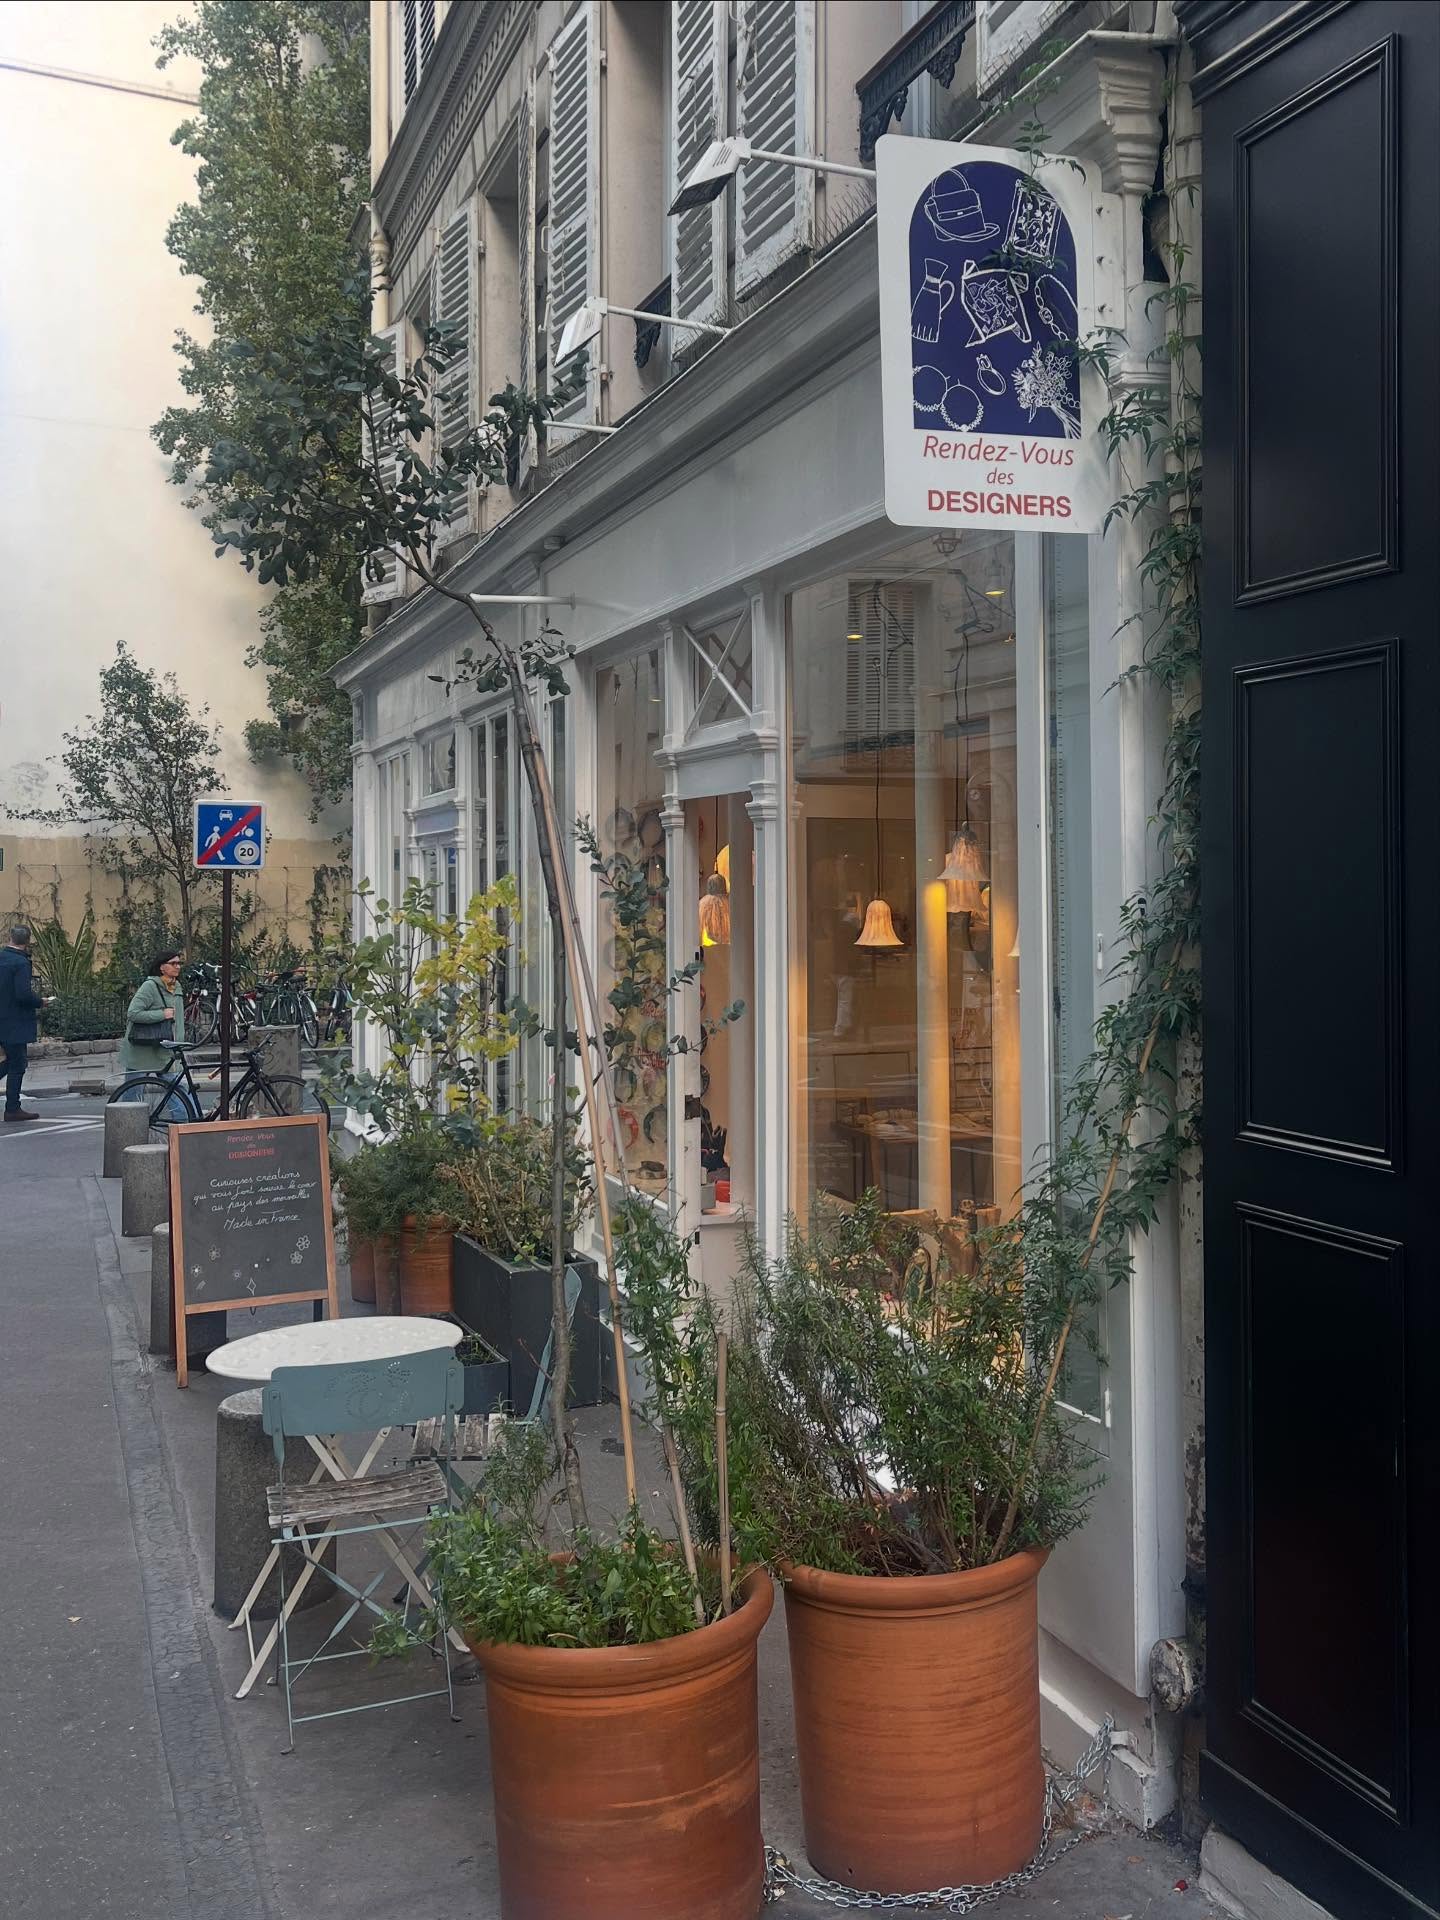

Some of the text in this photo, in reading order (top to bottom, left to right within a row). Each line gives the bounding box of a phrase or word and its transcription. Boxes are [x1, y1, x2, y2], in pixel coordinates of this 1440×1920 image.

[923, 435, 1074, 466] Rendez-Vous
[986, 467, 1014, 485] des
[927, 489, 1072, 518] DESIGNERS
[239, 847, 254, 857] 20
[193, 1192, 207, 1206] qui
[210, 1191, 232, 1199] vous
[211, 1203, 224, 1212] au
[226, 1200, 253, 1215] pays
[223, 1208, 301, 1231] Made in France
